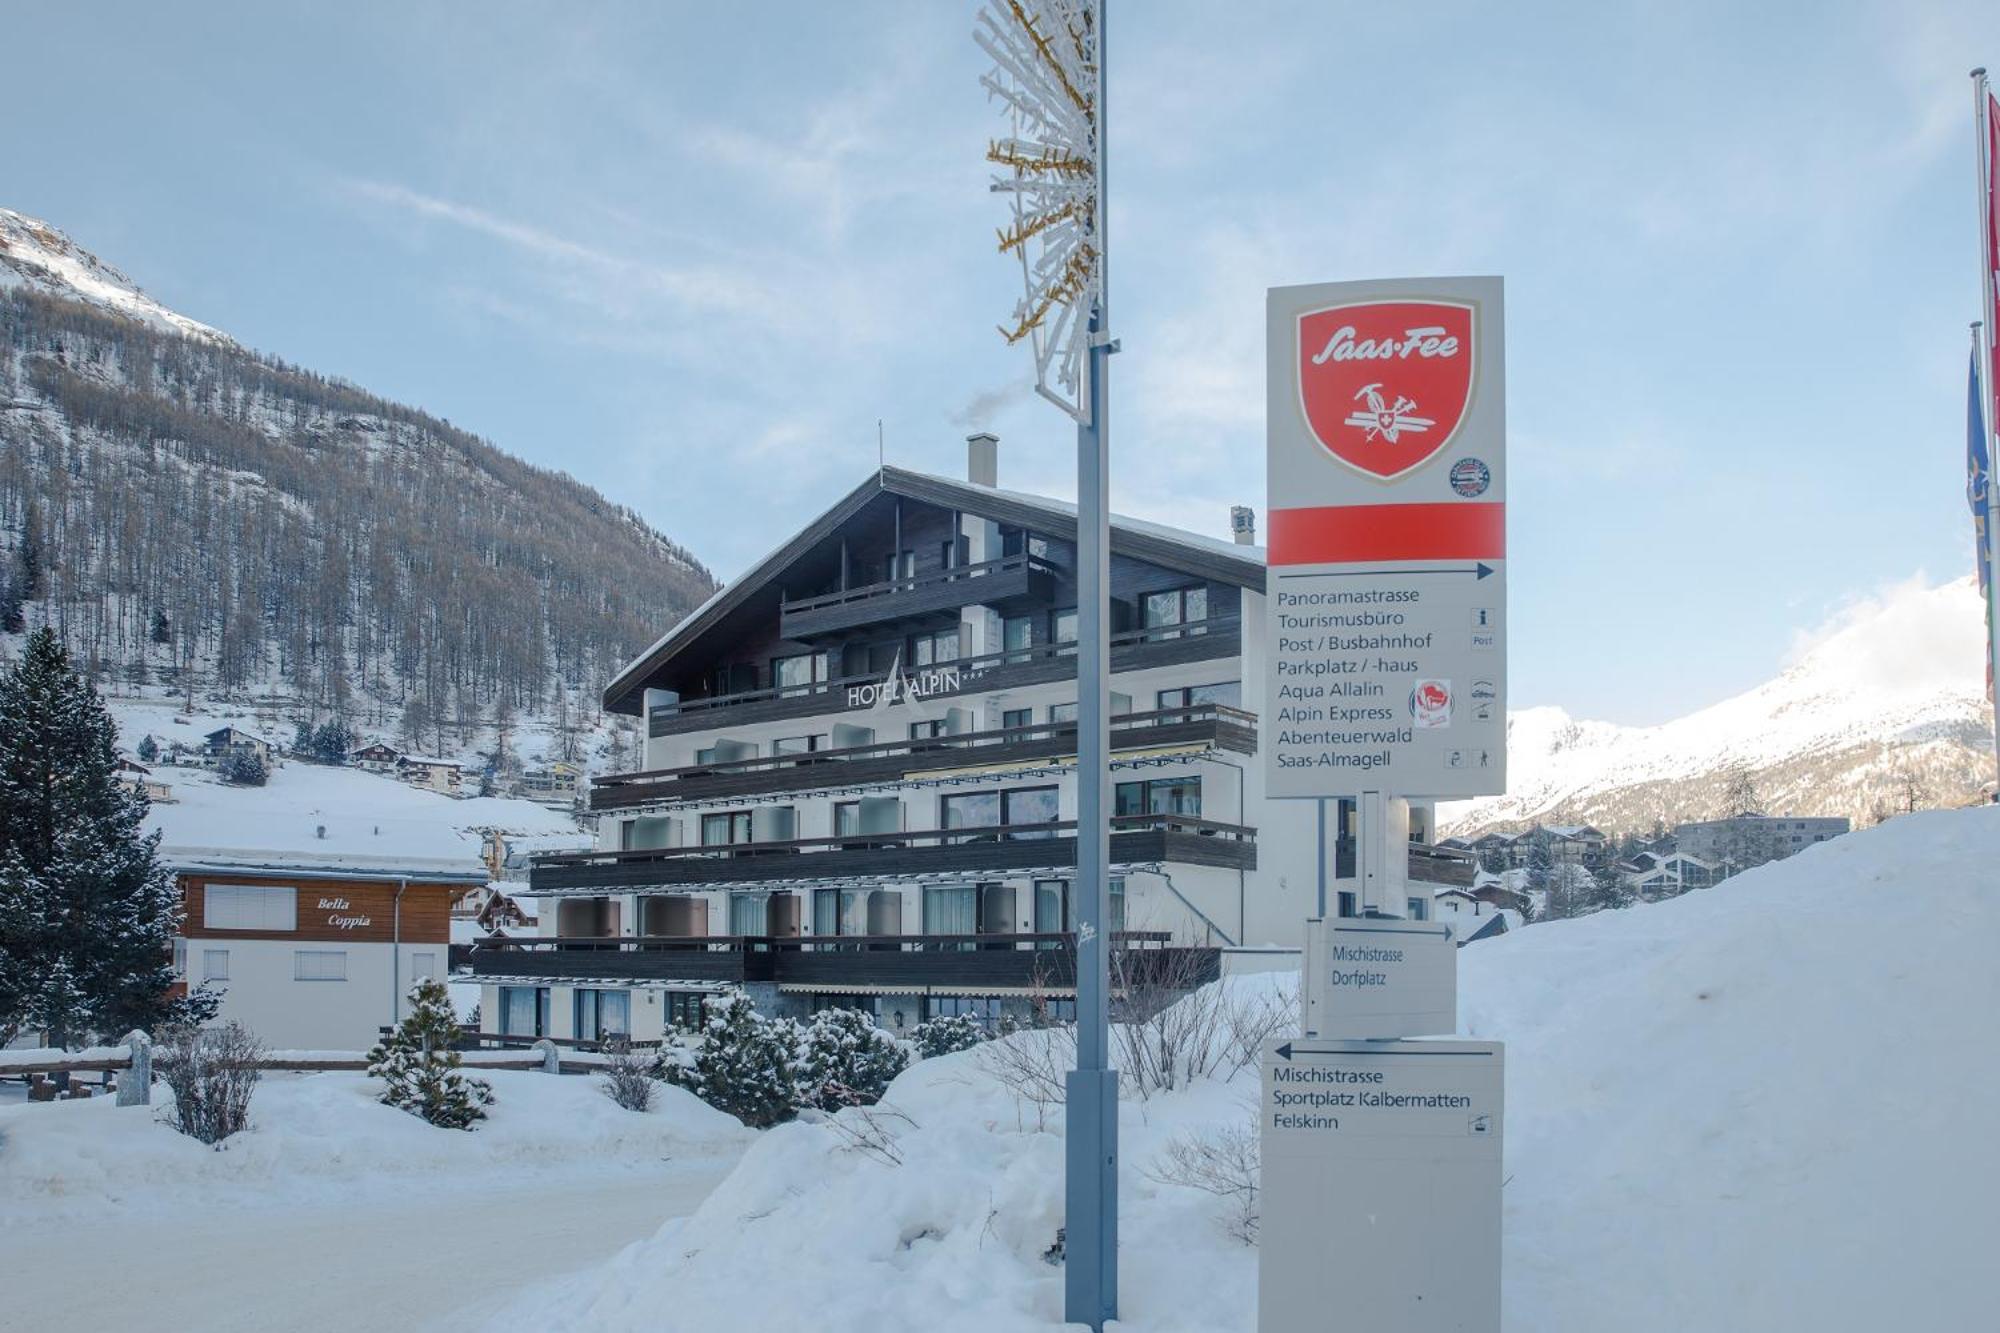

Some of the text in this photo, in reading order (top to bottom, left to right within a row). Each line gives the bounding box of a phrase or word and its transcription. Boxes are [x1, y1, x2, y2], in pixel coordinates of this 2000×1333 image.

[1278, 589, 1420, 606] Panoramastrasse
[1278, 611, 1404, 629] Tourismusbüro
[1279, 637, 1314, 652] Post
[1328, 632, 1433, 650] Busbahnhof
[1473, 636, 1493, 646] Post
[1278, 659, 1357, 678] Parkplatz
[848, 671, 960, 707] HOTEL ALPIN
[1278, 681, 1384, 701] Aqua Allalin
[1278, 706, 1393, 724] Alpin Express
[1278, 728, 1412, 745] Abenteuerwald
[1278, 750, 1391, 770] Saas-Almagell
[318, 898, 350, 910] Bella
[328, 914, 371, 930] Coppia
[1332, 946, 1403, 963] Mischistrasse
[1332, 970, 1386, 989] Dorfplatz
[1273, 1067, 1384, 1084] Mischistrasse
[1273, 1090, 1471, 1109] Sportplatz Kalbermatten
[1273, 1113, 1339, 1129] Felskinn
